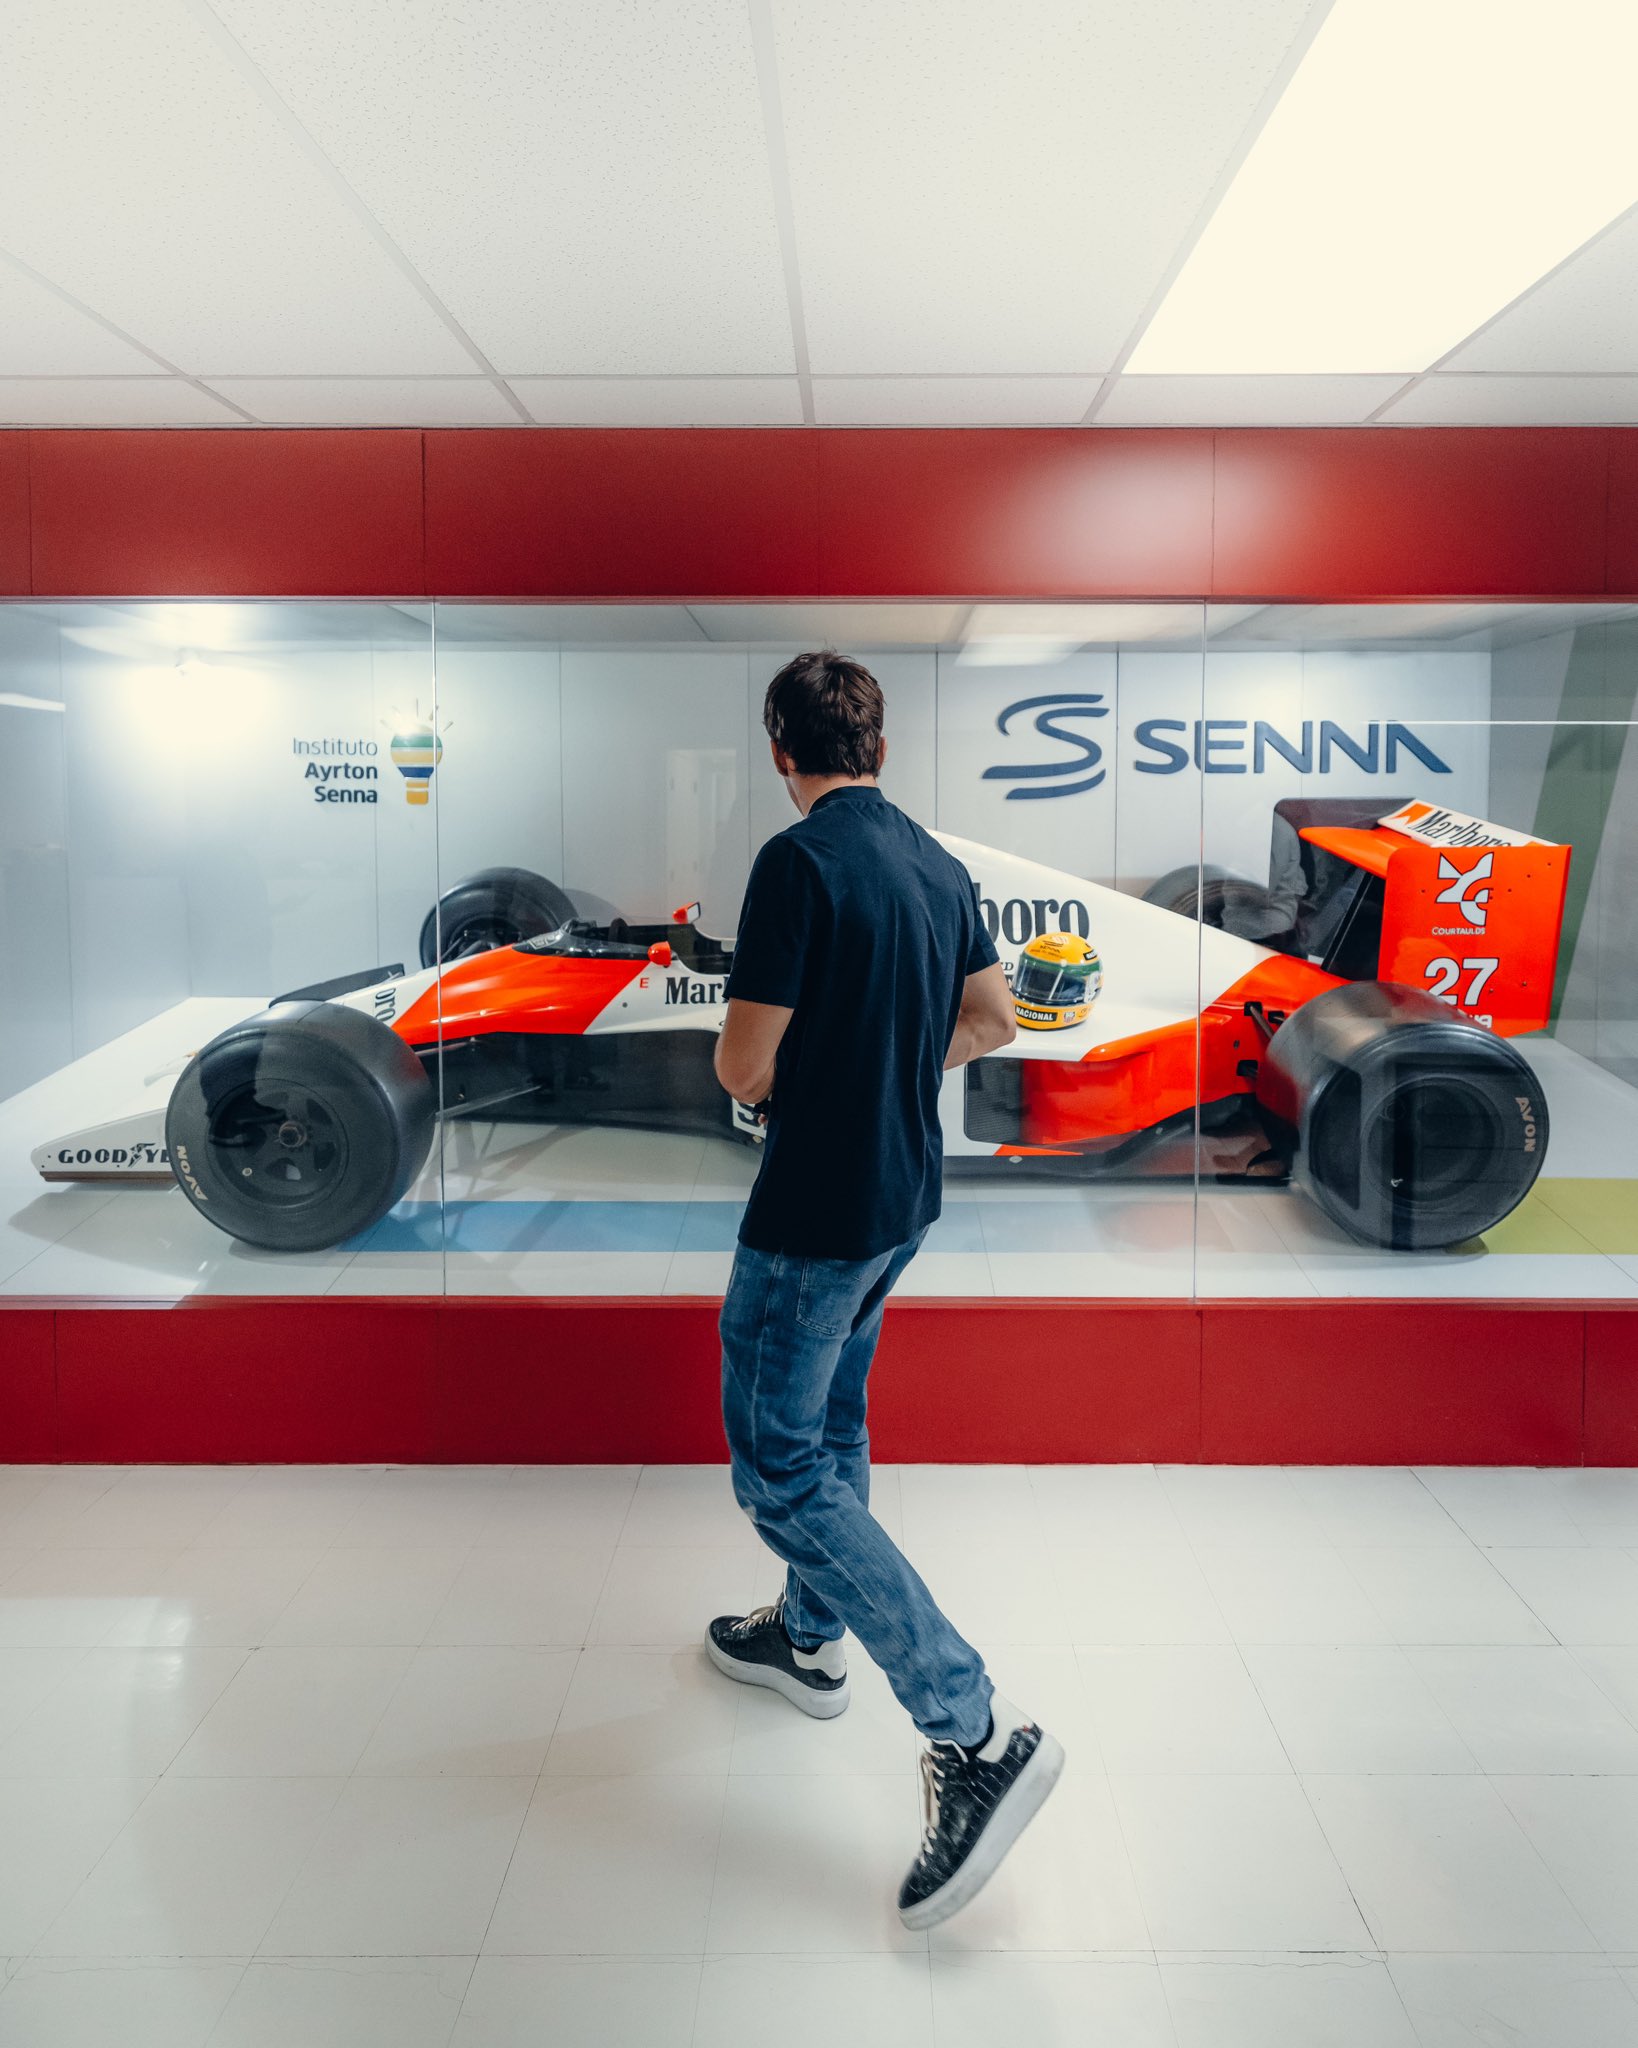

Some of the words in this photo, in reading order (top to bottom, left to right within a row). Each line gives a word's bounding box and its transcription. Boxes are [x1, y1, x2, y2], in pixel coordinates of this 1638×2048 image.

[293, 737, 378, 756] Instituto
[1134, 719, 1453, 774] SENNA
[304, 762, 378, 782] Ayrton
[314, 786, 378, 804] Senna
[1408, 810, 1511, 847] Marlbor
[1424, 957, 1500, 1006] 27
[1016, 1006, 1055, 1021] NACIONAL
[1515, 1096, 1537, 1152] AVON
[176, 1145, 208, 1200] AVON
